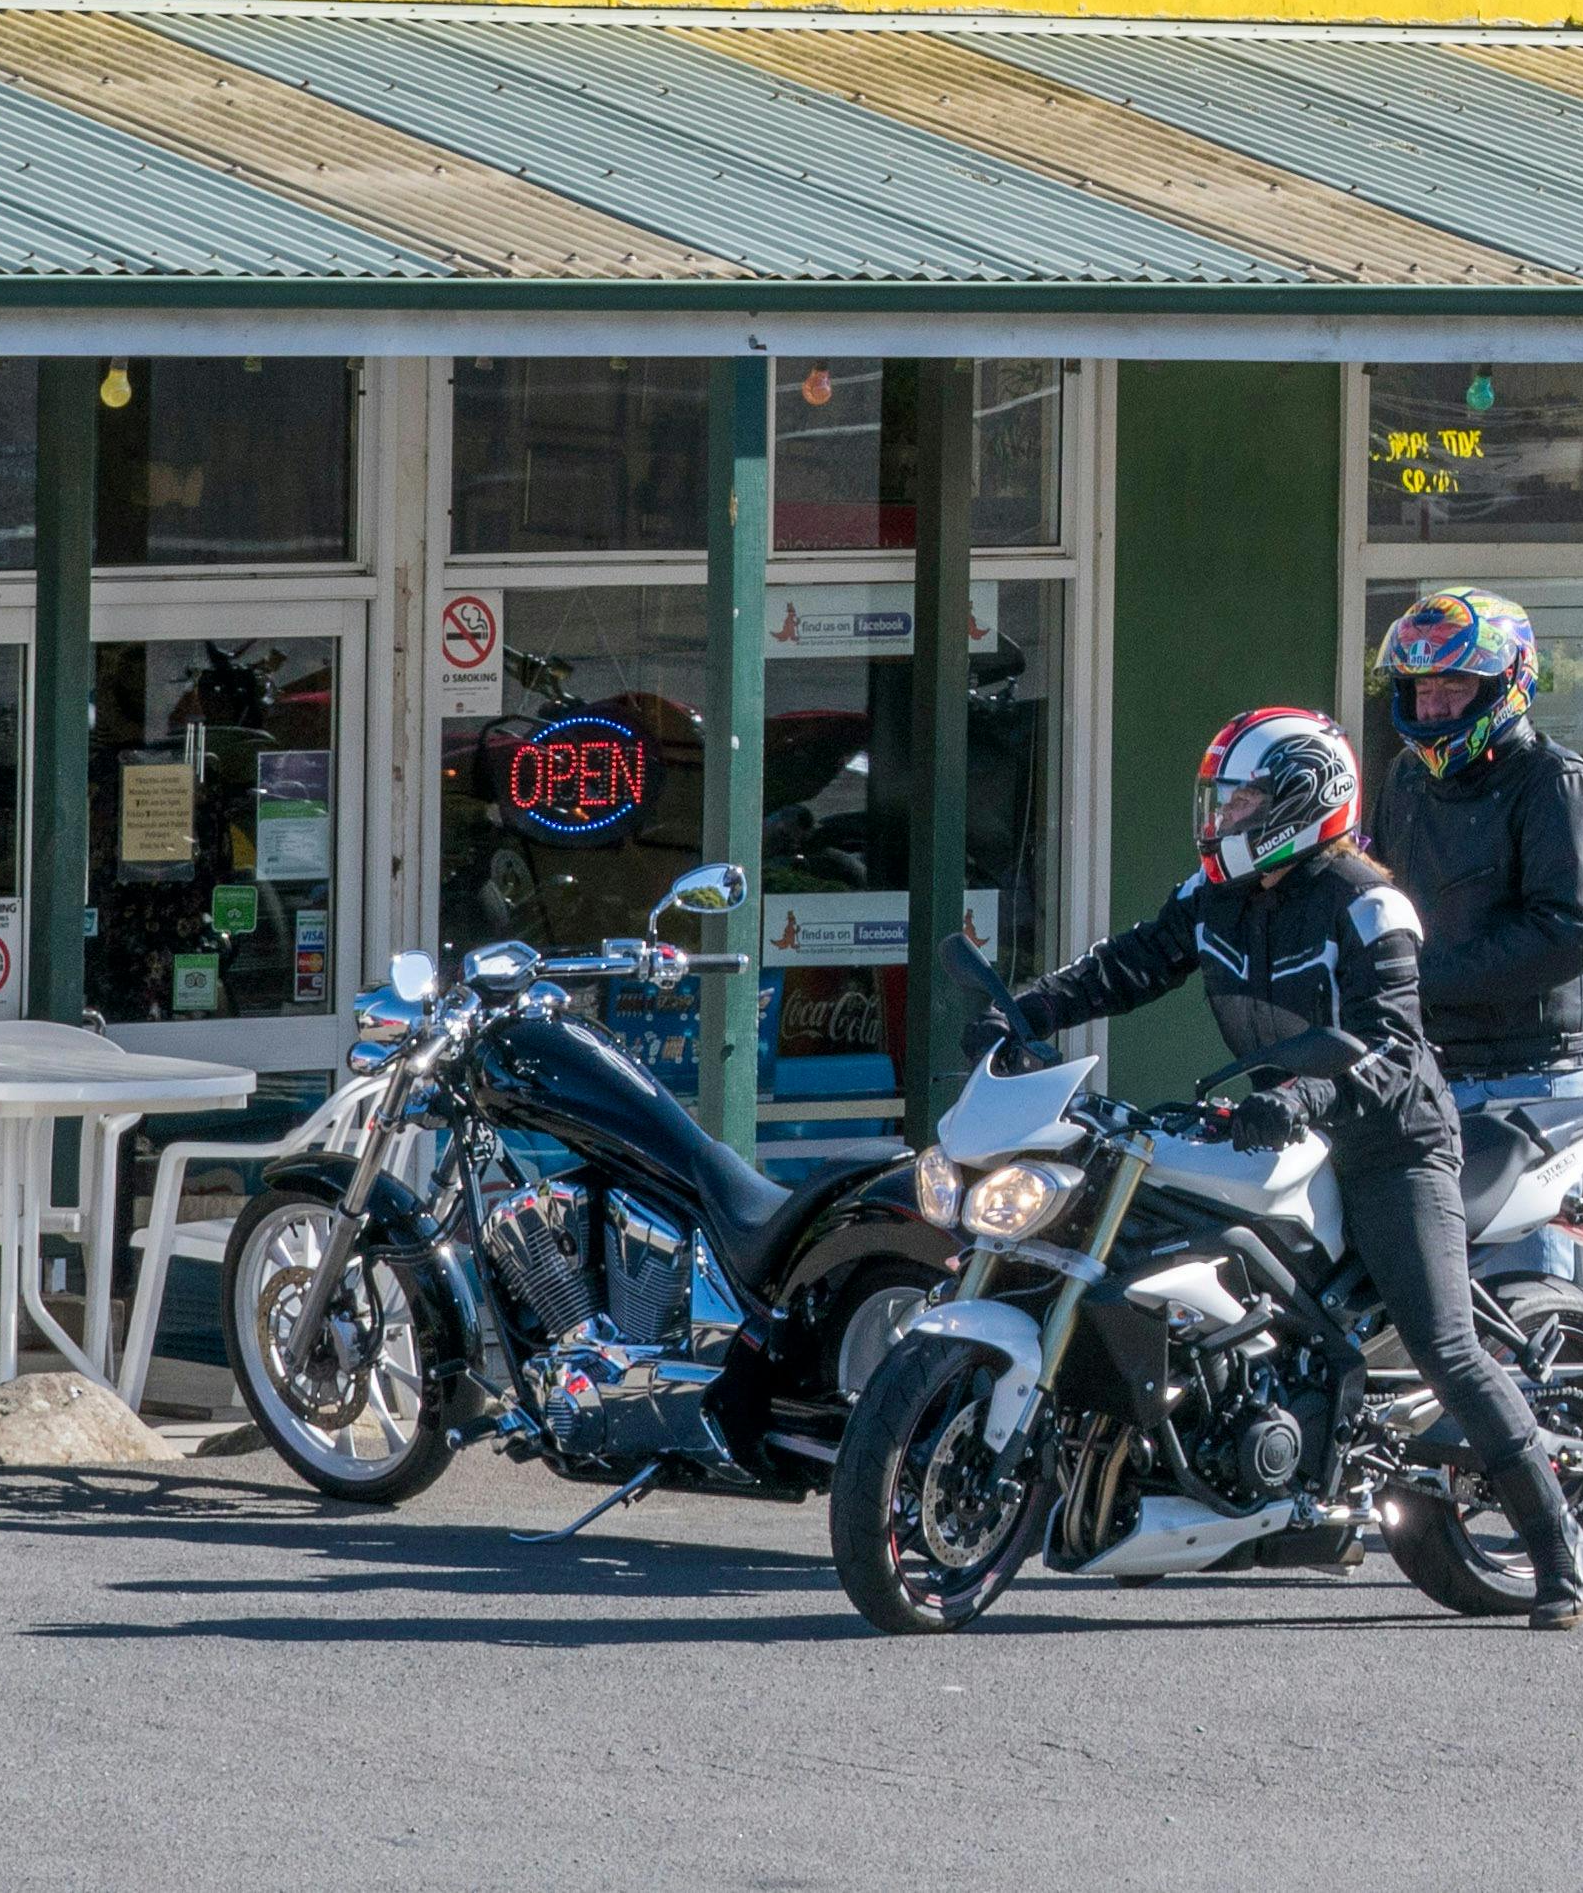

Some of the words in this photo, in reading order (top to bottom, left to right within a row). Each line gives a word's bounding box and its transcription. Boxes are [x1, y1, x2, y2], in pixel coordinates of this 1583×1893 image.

[802, 620, 821, 633] find
[823, 623, 835, 632] us
[838, 622, 851, 632] on
[858, 617, 904, 632] facebook
[452, 673, 497, 683] SMOKING
[510, 741, 644, 810] OPEN
[1328, 778, 1354, 798] Arai
[1256, 825, 1296, 856] DUCATI
[302, 929, 325, 942] VISA
[802, 926, 821, 940] find
[823, 930, 835, 939] us
[838, 929, 851, 939] on
[858, 926, 905, 940] facebook
